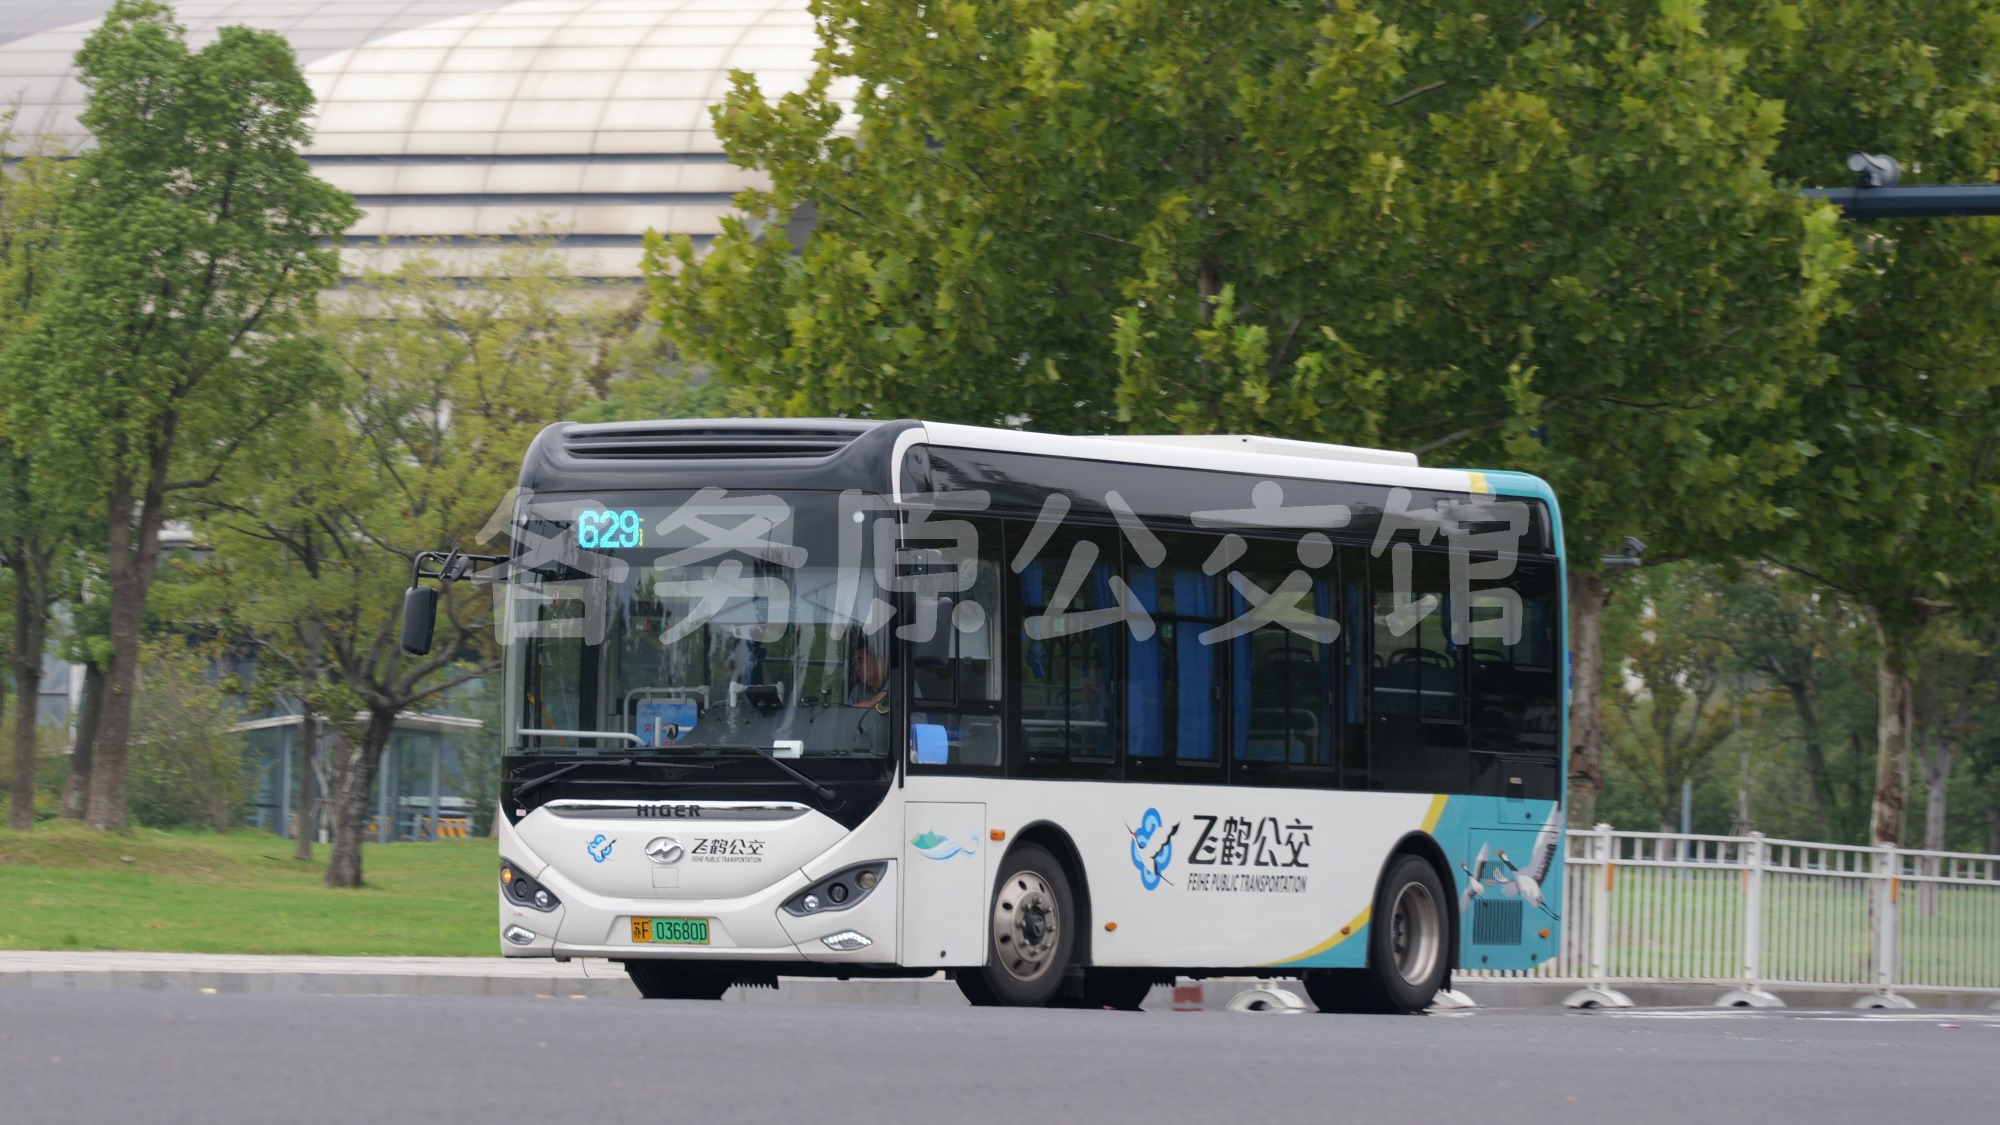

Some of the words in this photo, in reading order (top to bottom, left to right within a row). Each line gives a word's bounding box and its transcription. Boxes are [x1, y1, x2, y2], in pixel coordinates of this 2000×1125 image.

[637, 804, 701, 817] HIGER
[691, 838, 766, 855] 飞鹤公交
[1187, 814, 1314, 868] 飞鹤公交
[1187, 872, 1210, 891] FEIHE
[1211, 873, 1239, 892] PUBLIC
[1240, 874, 1308, 893] TRANSPORTATION
